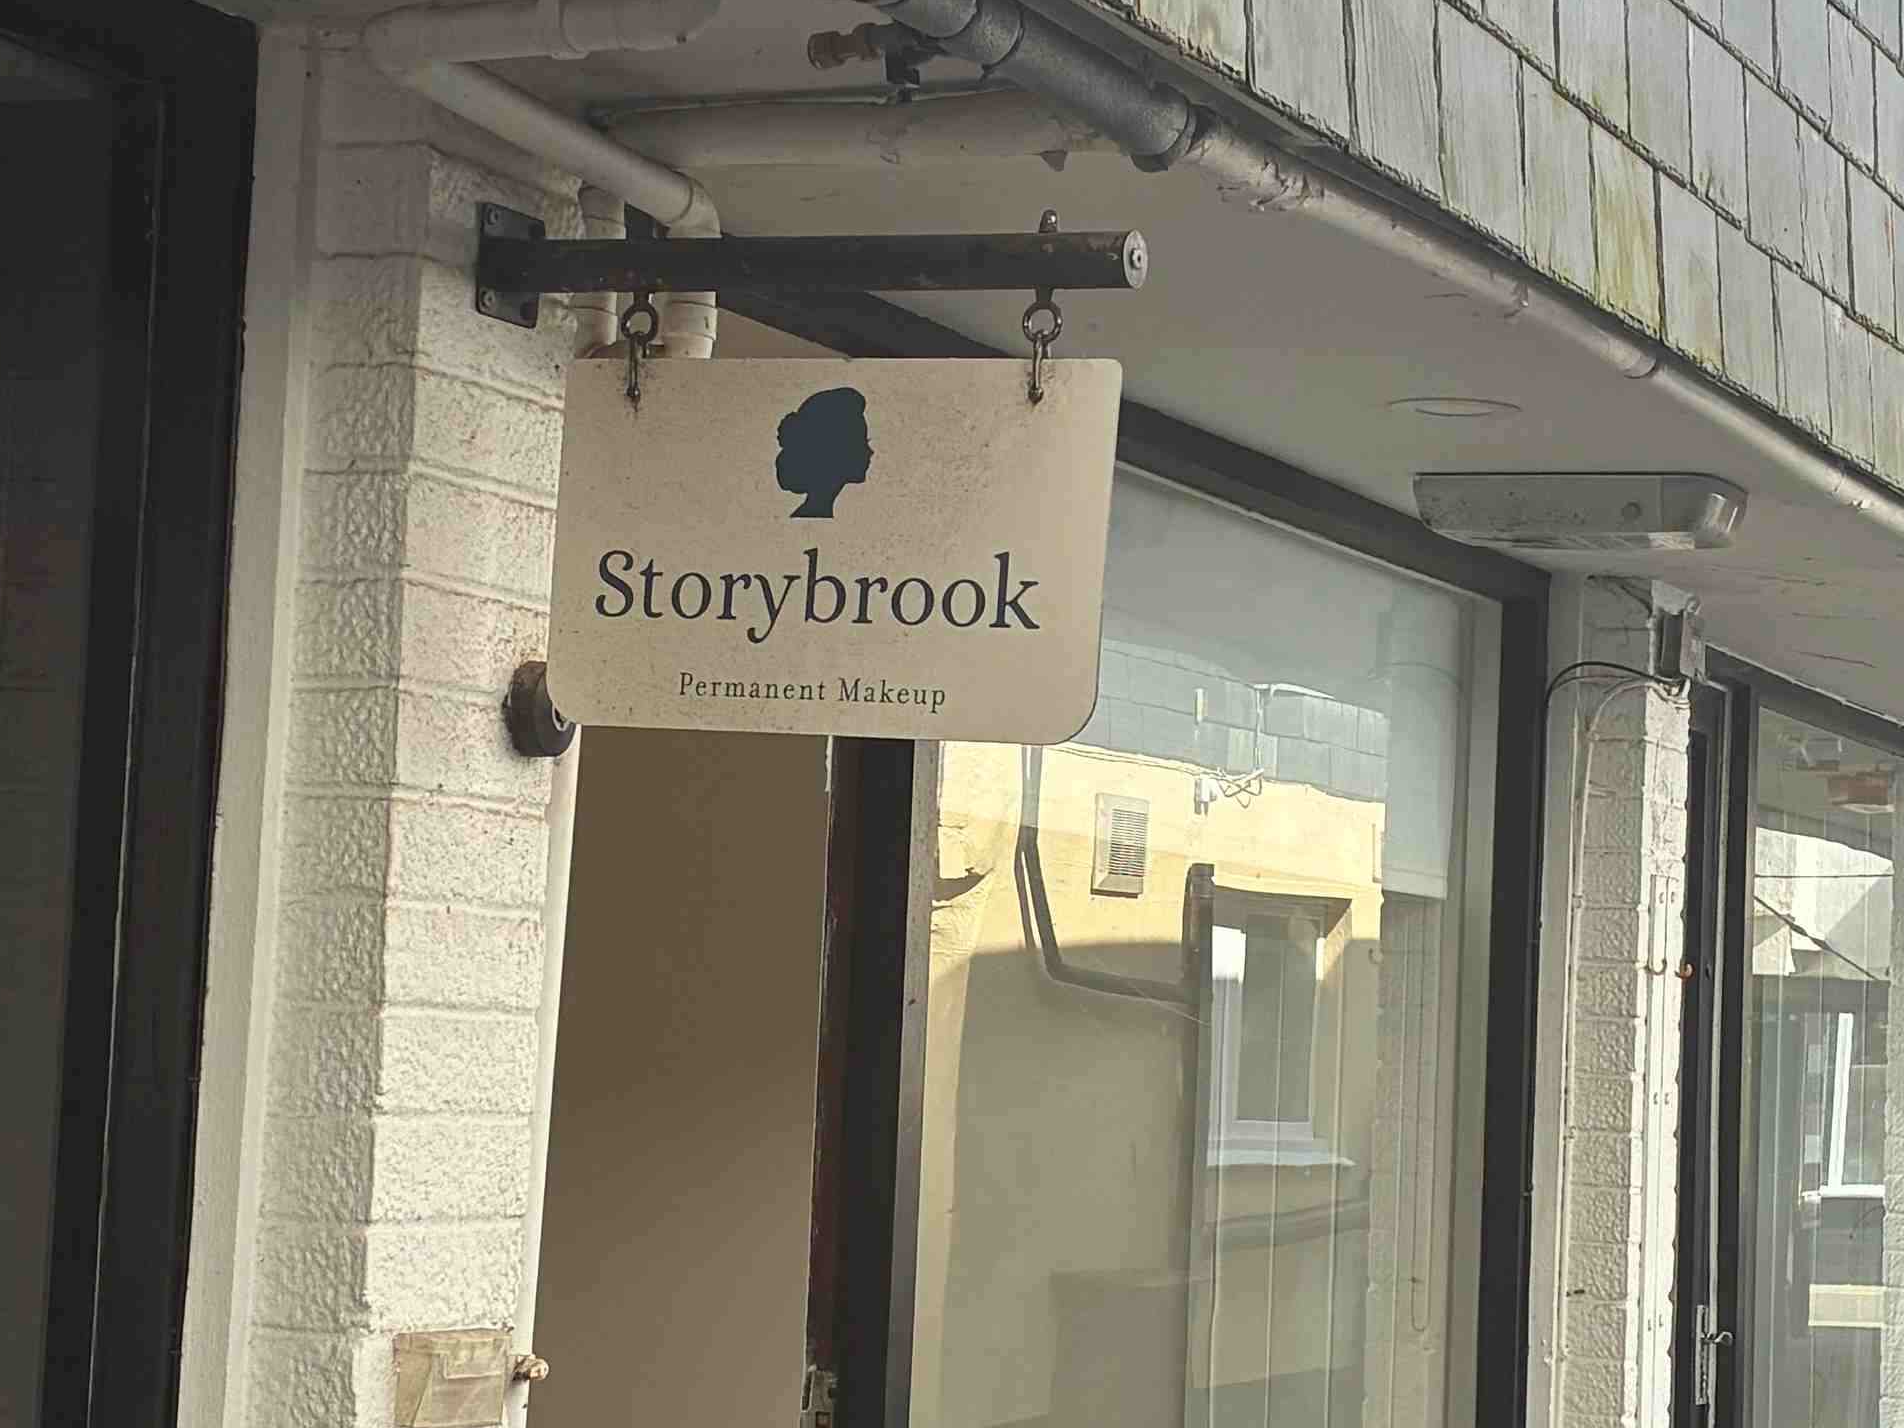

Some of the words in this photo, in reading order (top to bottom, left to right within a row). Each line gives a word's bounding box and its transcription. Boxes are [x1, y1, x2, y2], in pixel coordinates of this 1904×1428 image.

[594, 546, 1040, 644] Storybrook
[679, 671, 827, 701] Permanent
[836, 676, 946, 715] Makeup
